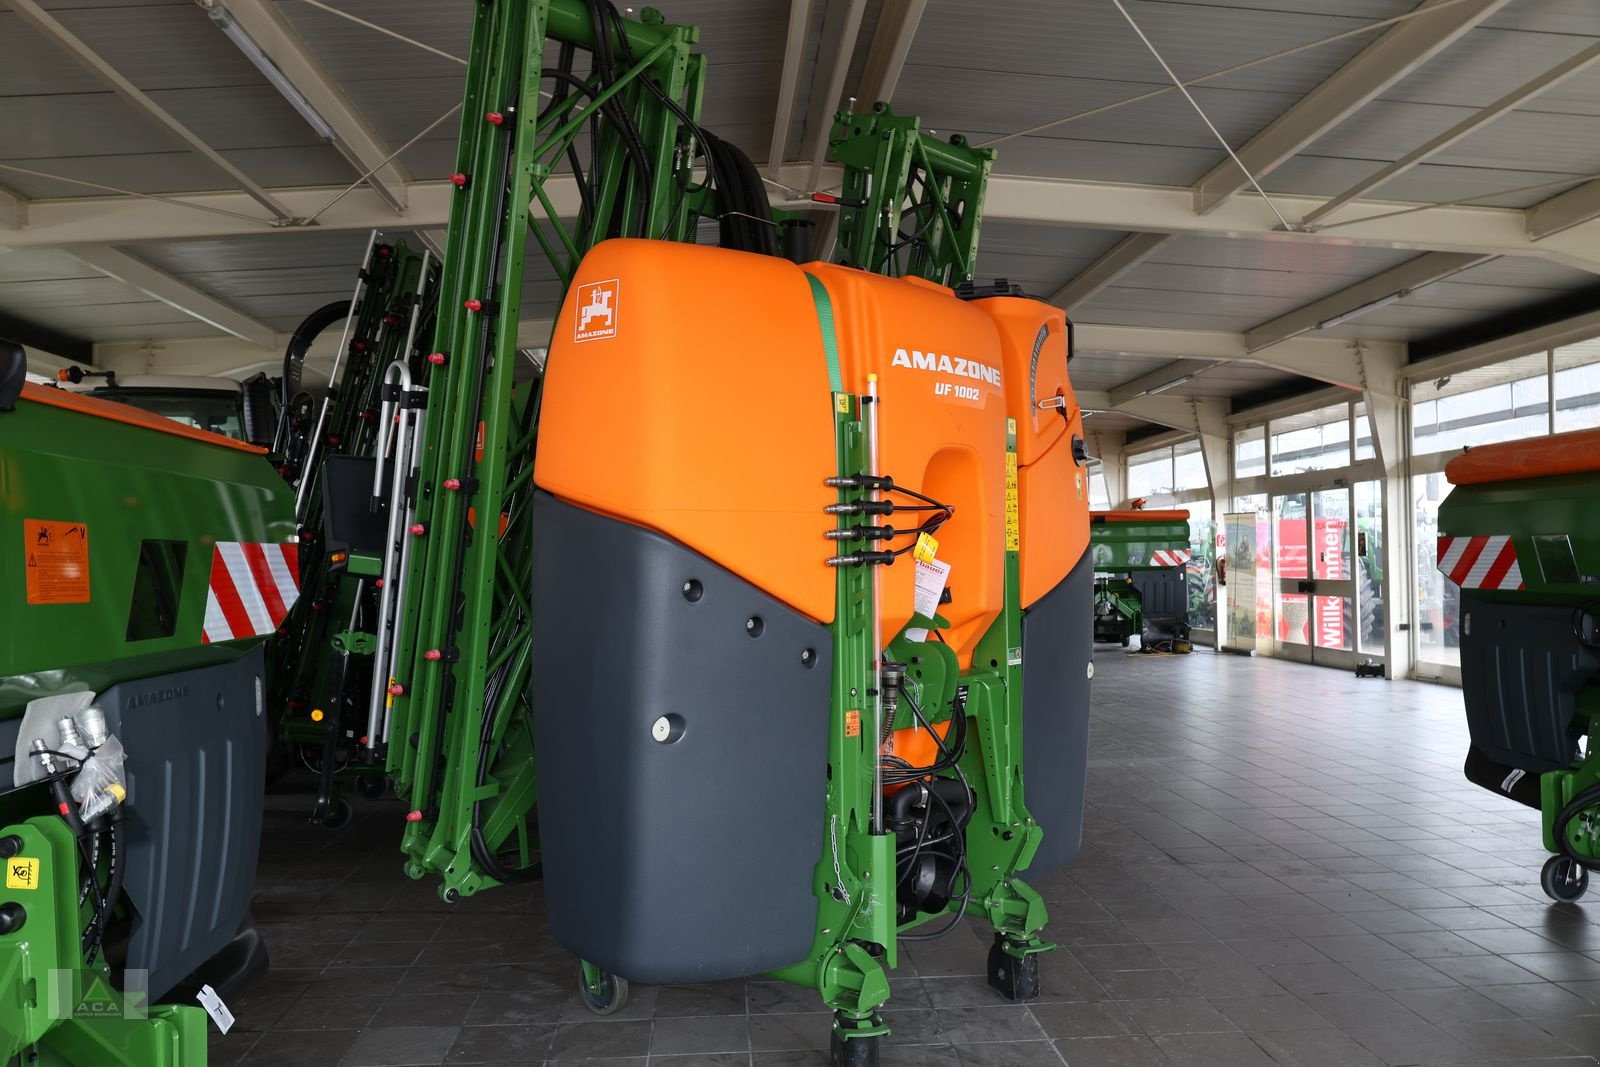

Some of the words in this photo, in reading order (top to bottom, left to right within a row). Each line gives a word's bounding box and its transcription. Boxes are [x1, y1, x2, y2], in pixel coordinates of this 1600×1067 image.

[576, 328, 614, 339] AMAZONE
[891, 348, 1001, 387] AMAZONE
[934, 382, 952, 396] UF
[954, 385, 980, 401] 1002
[1322, 520, 1342, 647] Willkmmen
[125, 685, 190, 710] AMAZONE
